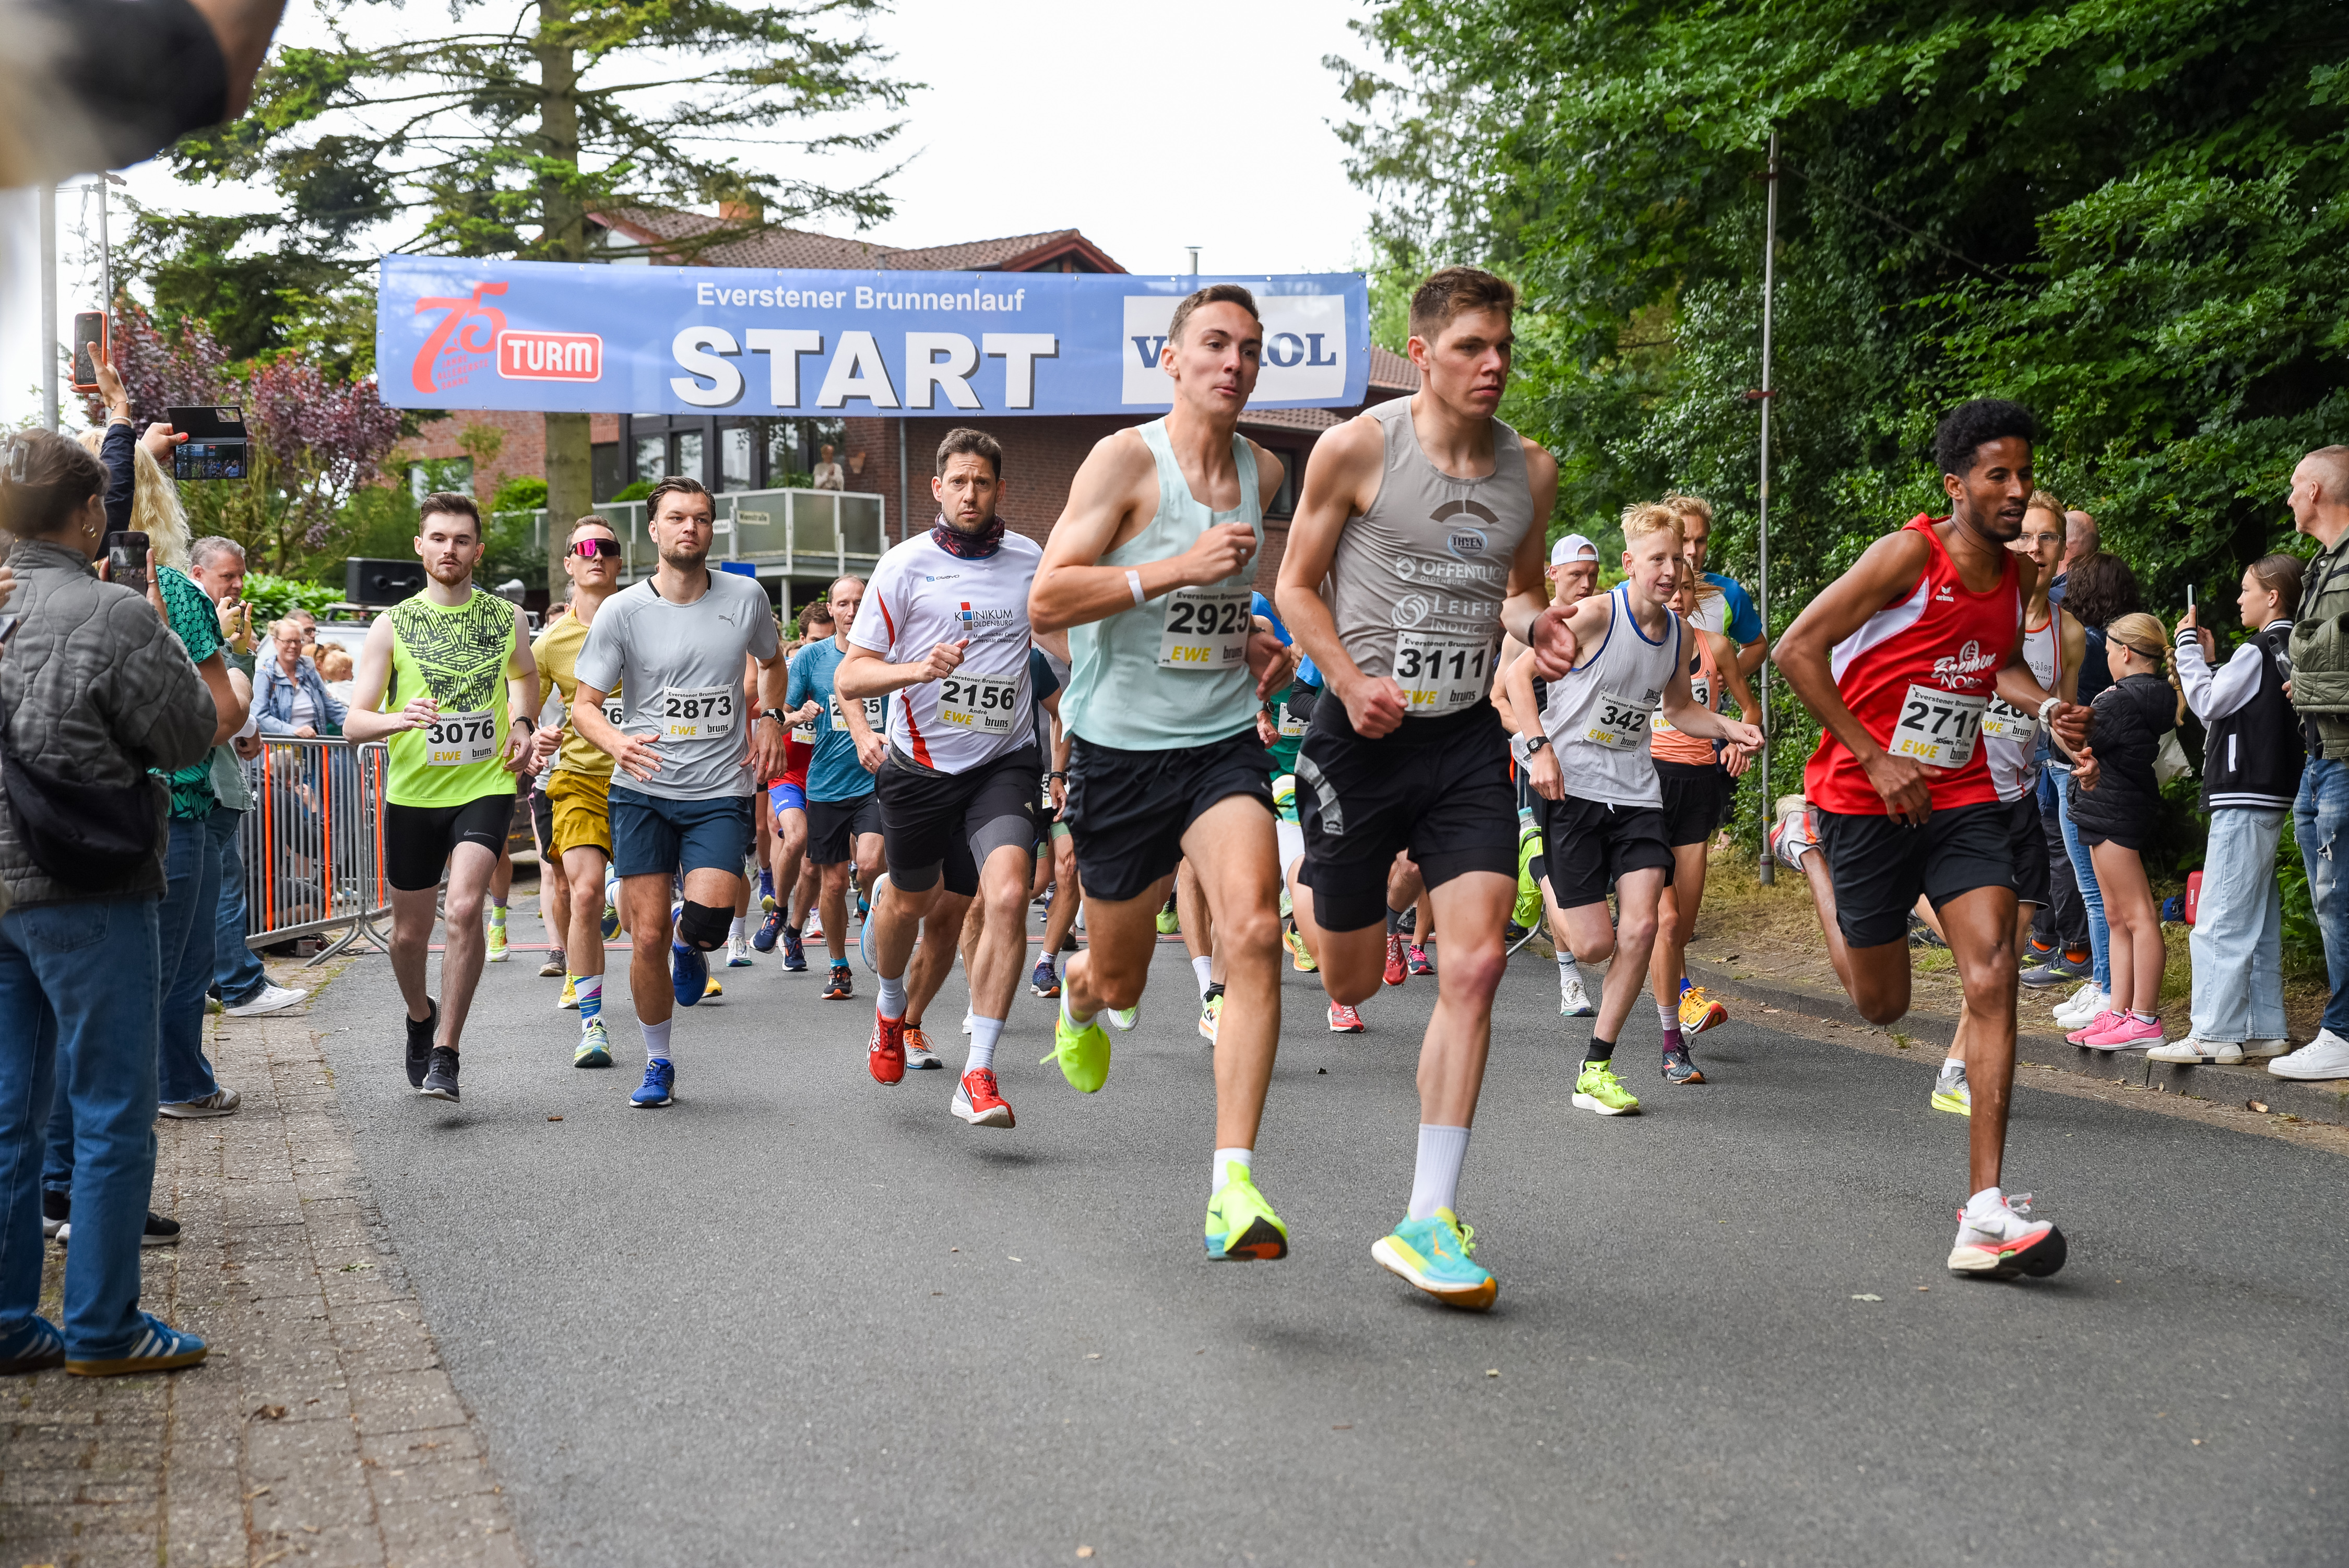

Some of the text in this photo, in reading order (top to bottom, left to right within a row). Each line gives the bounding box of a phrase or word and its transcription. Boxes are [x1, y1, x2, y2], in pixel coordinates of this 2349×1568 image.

[697, 282, 1025, 312] Everstener Brunnenlauf
[411, 281, 509, 394] 75
[507, 339, 592, 372] TURM
[1131, 332, 1336, 367] VOL
[670, 326, 1059, 410] START
[1453, 537, 1482, 548] THYEN
[1420, 575, 1467, 586] OLDENBURG
[1177, 591, 1219, 600] Everstener
[1167, 601, 1250, 636] 2925
[477, 636, 497, 647] NIKE
[1405, 638, 1446, 647] Everstener
[1171, 646, 1212, 662] EWE
[1397, 648, 1486, 680] 3111
[1931, 652, 1997, 679] Bremen
[2029, 661, 2053, 675] chloy
[1940, 673, 1983, 690] NORD
[940, 680, 1015, 710] 2156
[1449, 690, 1476, 703] bruns
[1601, 696, 1629, 708] Everstener
[1914, 692, 1954, 705] Everstener
[666, 696, 732, 719] 2873
[462, 712, 492, 721] Brunnenlauf
[943, 710, 974, 726] EWE
[984, 716, 1009, 728] bruns
[1600, 705, 1646, 732] 342
[1654, 719, 1670, 728] EW
[1901, 701, 1982, 738] 2711
[428, 719, 494, 744] 3076
[670, 724, 697, 735] EWE
[707, 724, 729, 733] bruns
[1982, 719, 2003, 733] WE
[2012, 724, 2032, 737] bruns
[1588, 729, 1615, 743] EWE
[1620, 736, 1638, 747] bruns
[434, 751, 461, 761] EWE
[472, 747, 492, 757] bruns
[1900, 739, 1940, 759] EWE
[1949, 747, 1970, 760] bruns
